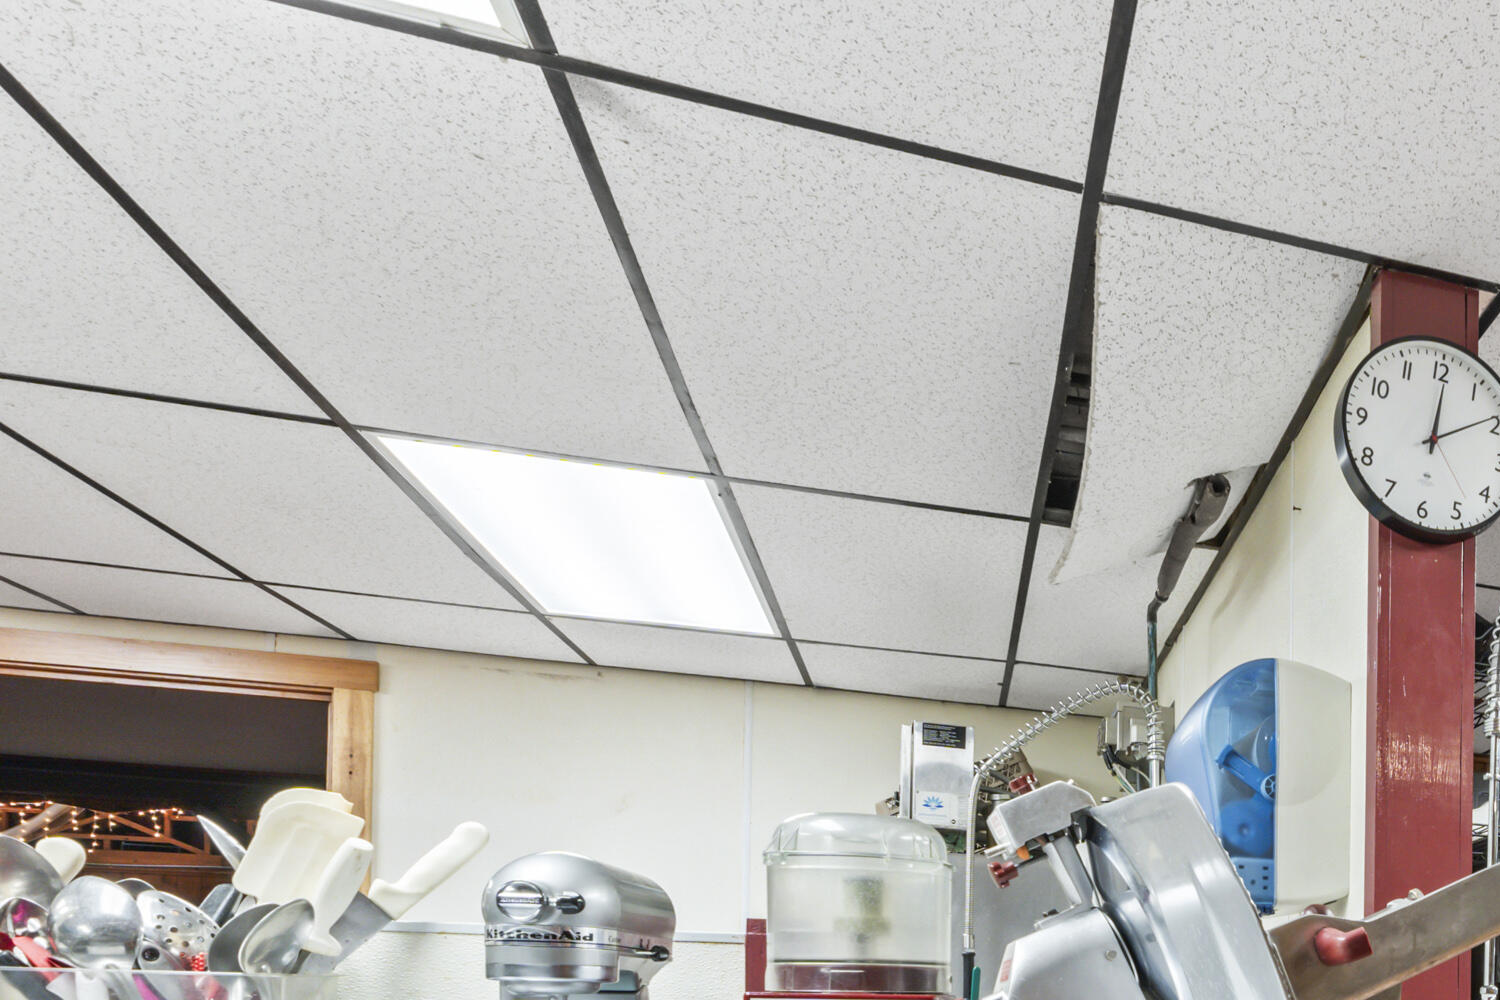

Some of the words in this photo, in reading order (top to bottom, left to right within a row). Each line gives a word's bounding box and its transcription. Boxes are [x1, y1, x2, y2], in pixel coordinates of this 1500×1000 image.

[1402, 360, 1412, 381] 11
[1433, 361, 1449, 384] 12
[1371, 377, 1389, 399] 10
[1471, 383, 1477, 401] 1
[1356, 407, 1368, 425] 9
[1489, 416, 1500, 435] 2
[1361, 447, 1374, 466] 8
[1385, 478, 1397, 497] 7
[1479, 486, 1490, 503] 4
[1417, 501, 1428, 519] 6
[1450, 502, 1462, 520] 5
[486, 928, 594, 942] KitchenAid
